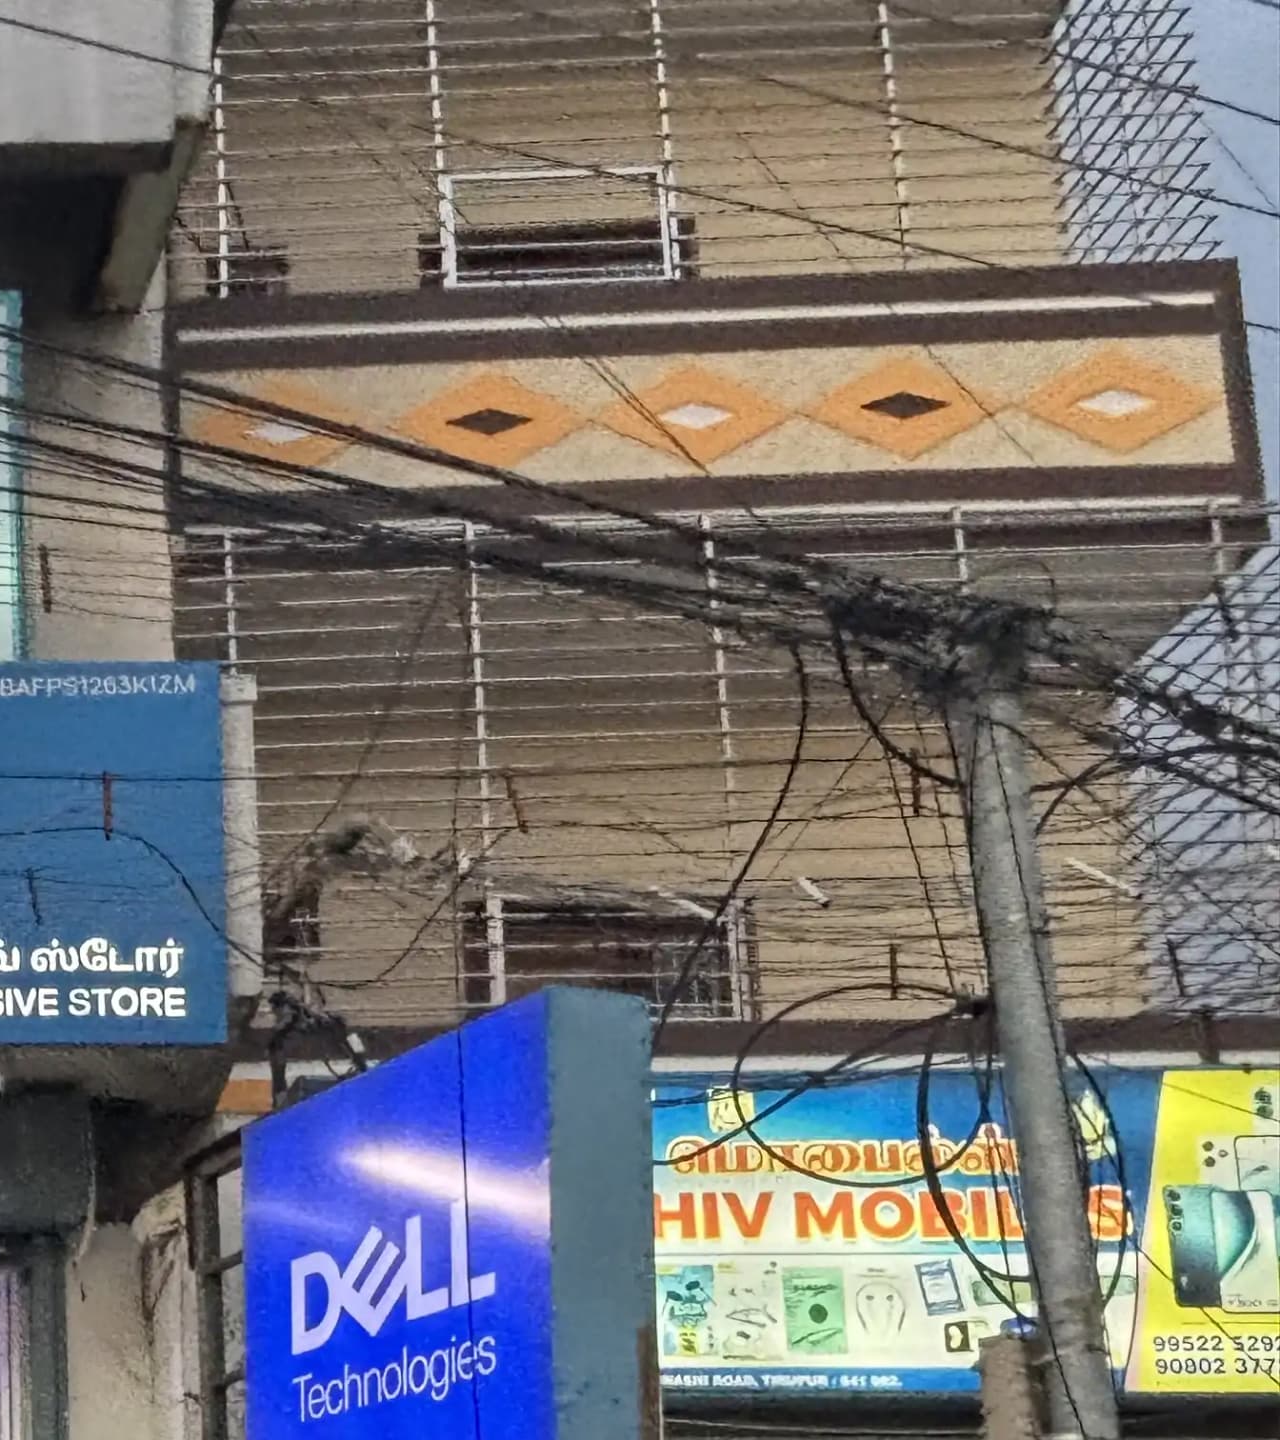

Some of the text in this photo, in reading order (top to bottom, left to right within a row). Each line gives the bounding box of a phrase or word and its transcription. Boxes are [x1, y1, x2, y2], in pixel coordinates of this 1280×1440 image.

[30, 937, 185, 978] ஸ்டோர்
[67, 987, 188, 1018] STORE
[793, 1184, 1130, 1241] MOBILS
[290, 1197, 497, 1356] DELL
[291, 1334, 497, 1423] Technologies
